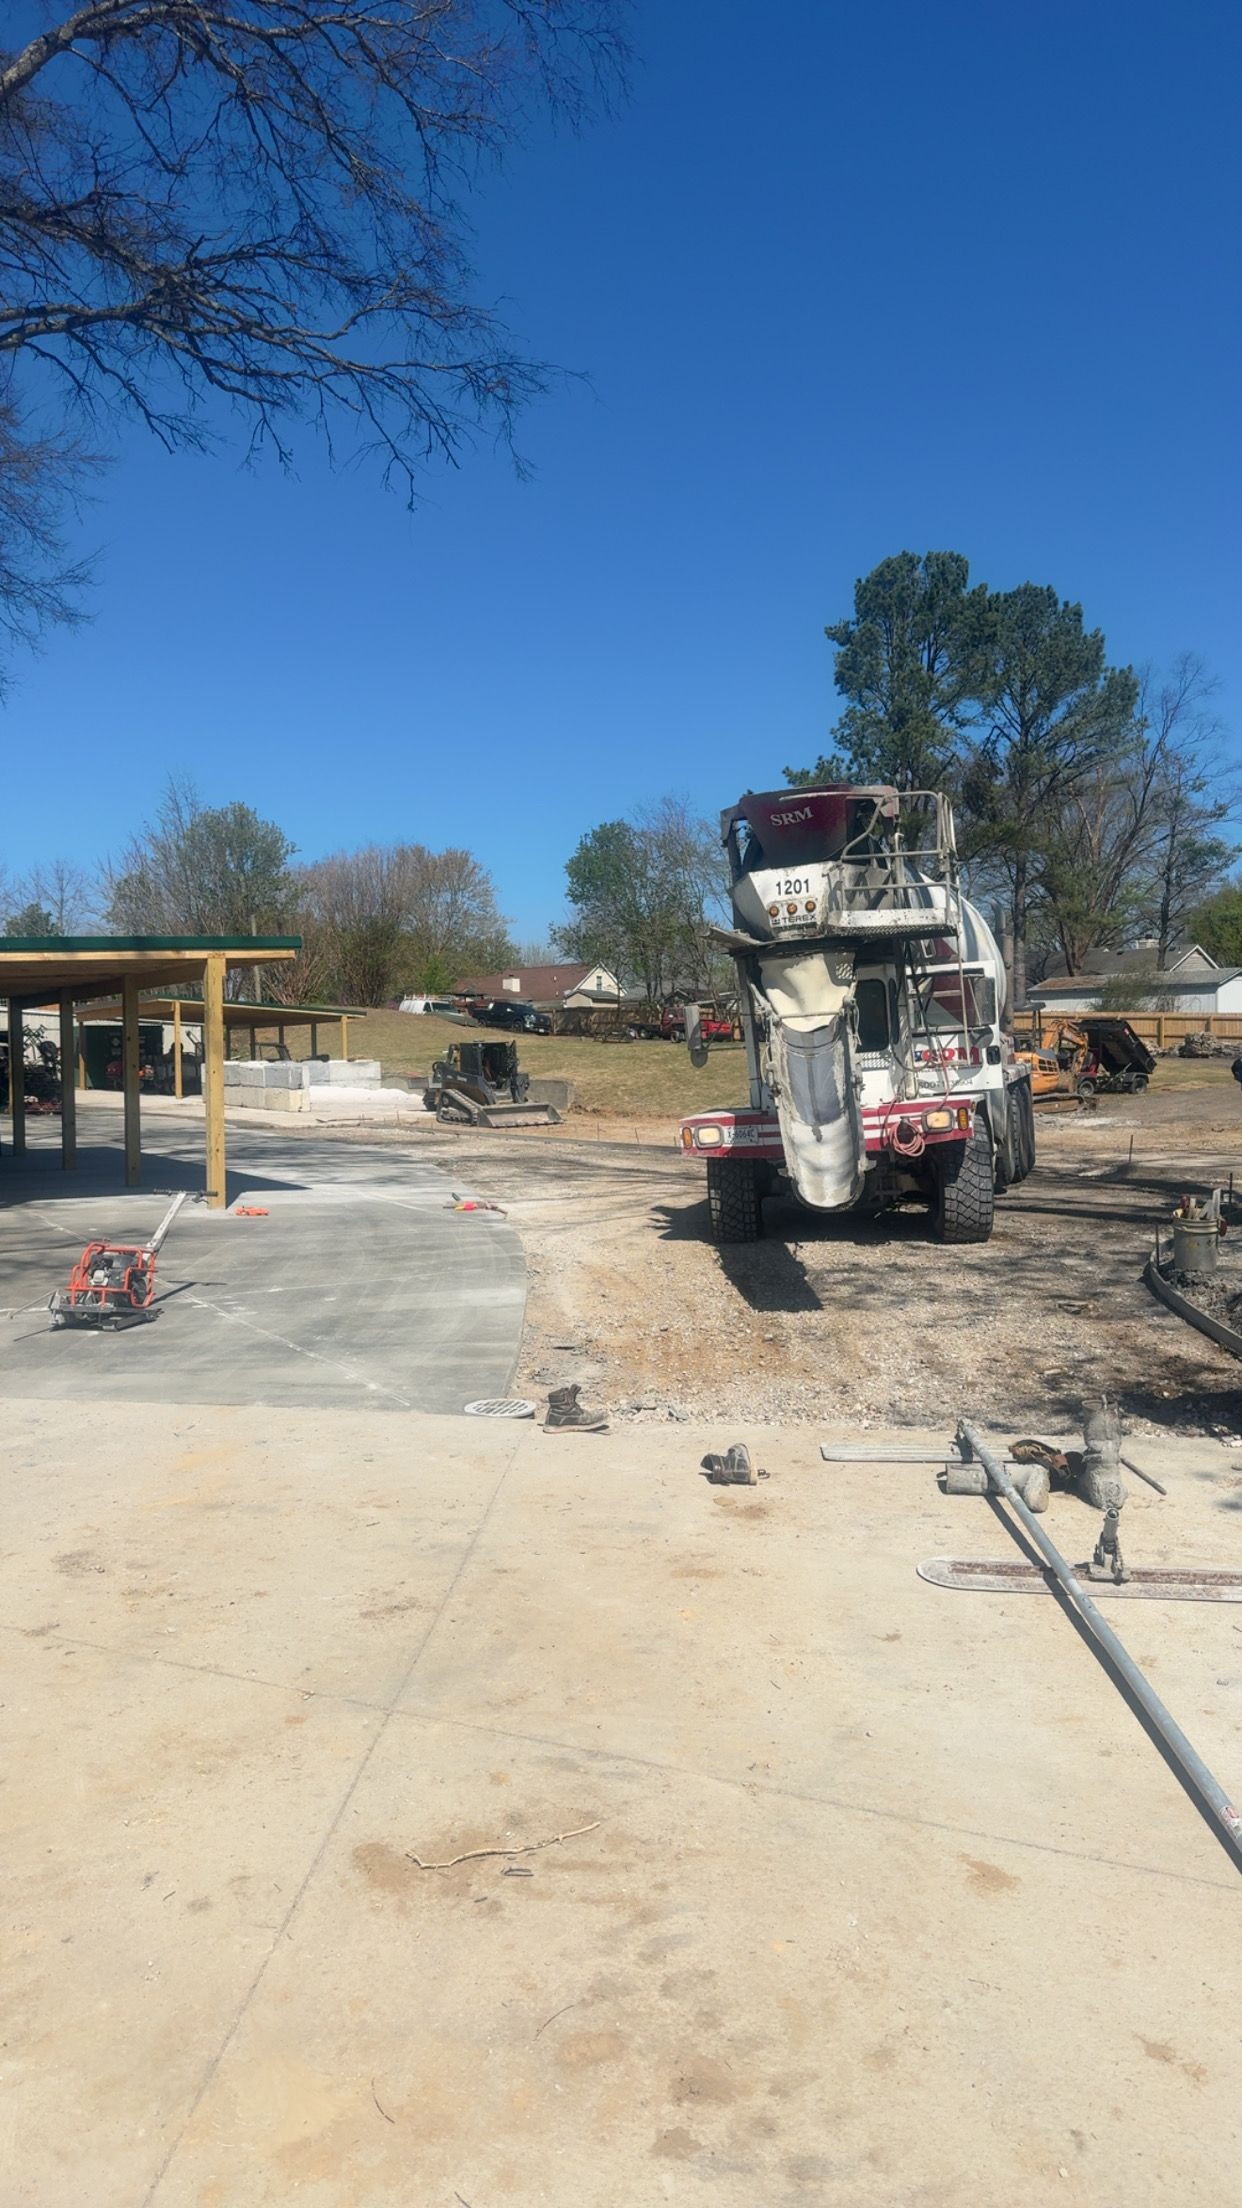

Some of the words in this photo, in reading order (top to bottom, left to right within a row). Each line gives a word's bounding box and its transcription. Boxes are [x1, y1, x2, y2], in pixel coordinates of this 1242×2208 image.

[770, 806, 814, 826] SRM
[776, 879, 809, 896] 1201
[781, 914, 817, 923] TEREX
